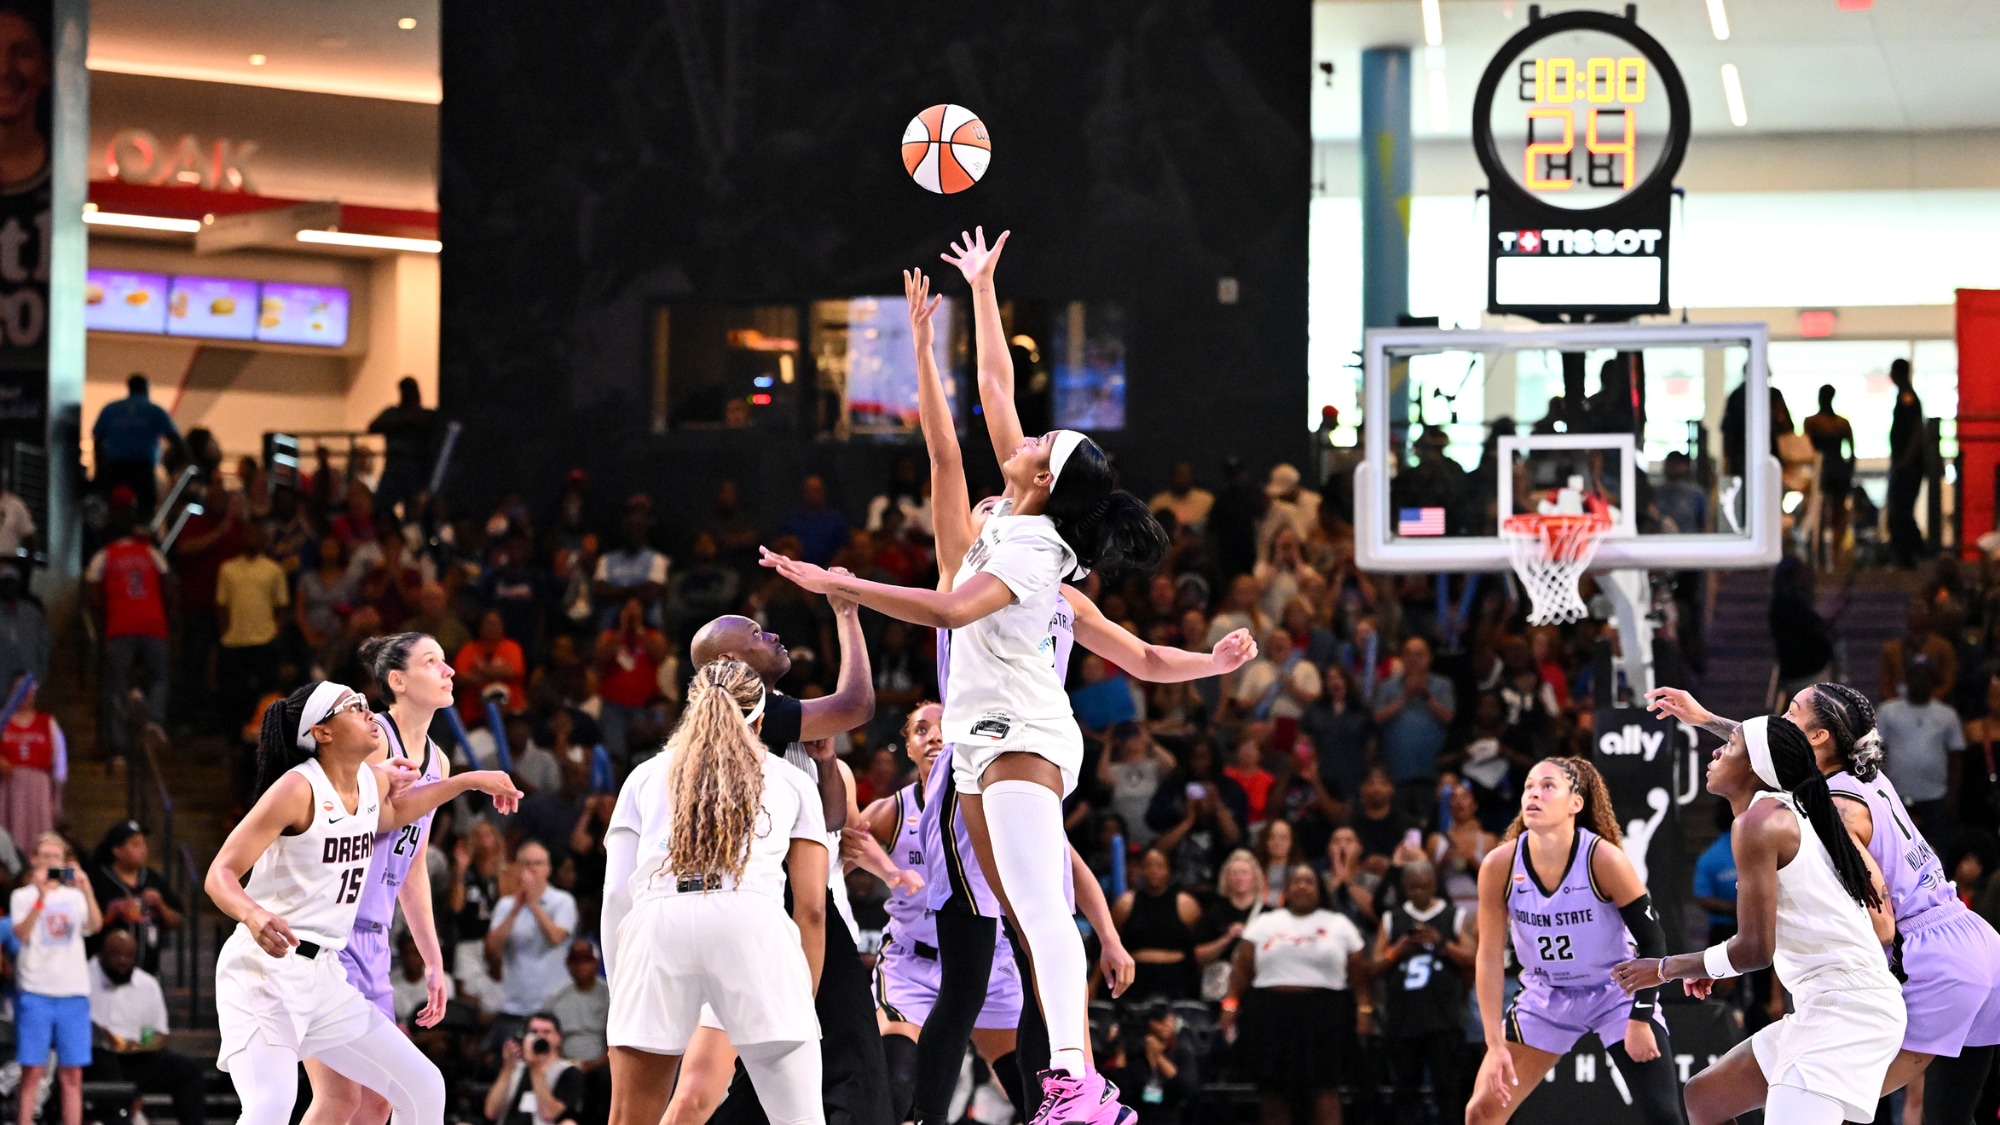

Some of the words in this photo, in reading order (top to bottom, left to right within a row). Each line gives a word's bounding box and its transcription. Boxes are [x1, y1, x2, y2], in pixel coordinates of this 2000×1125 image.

[1535, 57, 1646, 103] 10:00
[105, 129, 259, 194] OAK
[1526, 107, 1636, 190] 24
[1541, 229, 1662, 254] TISSOT
[1599, 724, 1664, 761] ally
[393, 824, 421, 859] 24
[336, 867, 364, 904] 15
[1515, 909, 1552, 927] GOLDEN
[1555, 908, 1594, 927] STATE
[1537, 934, 1574, 961] 22
